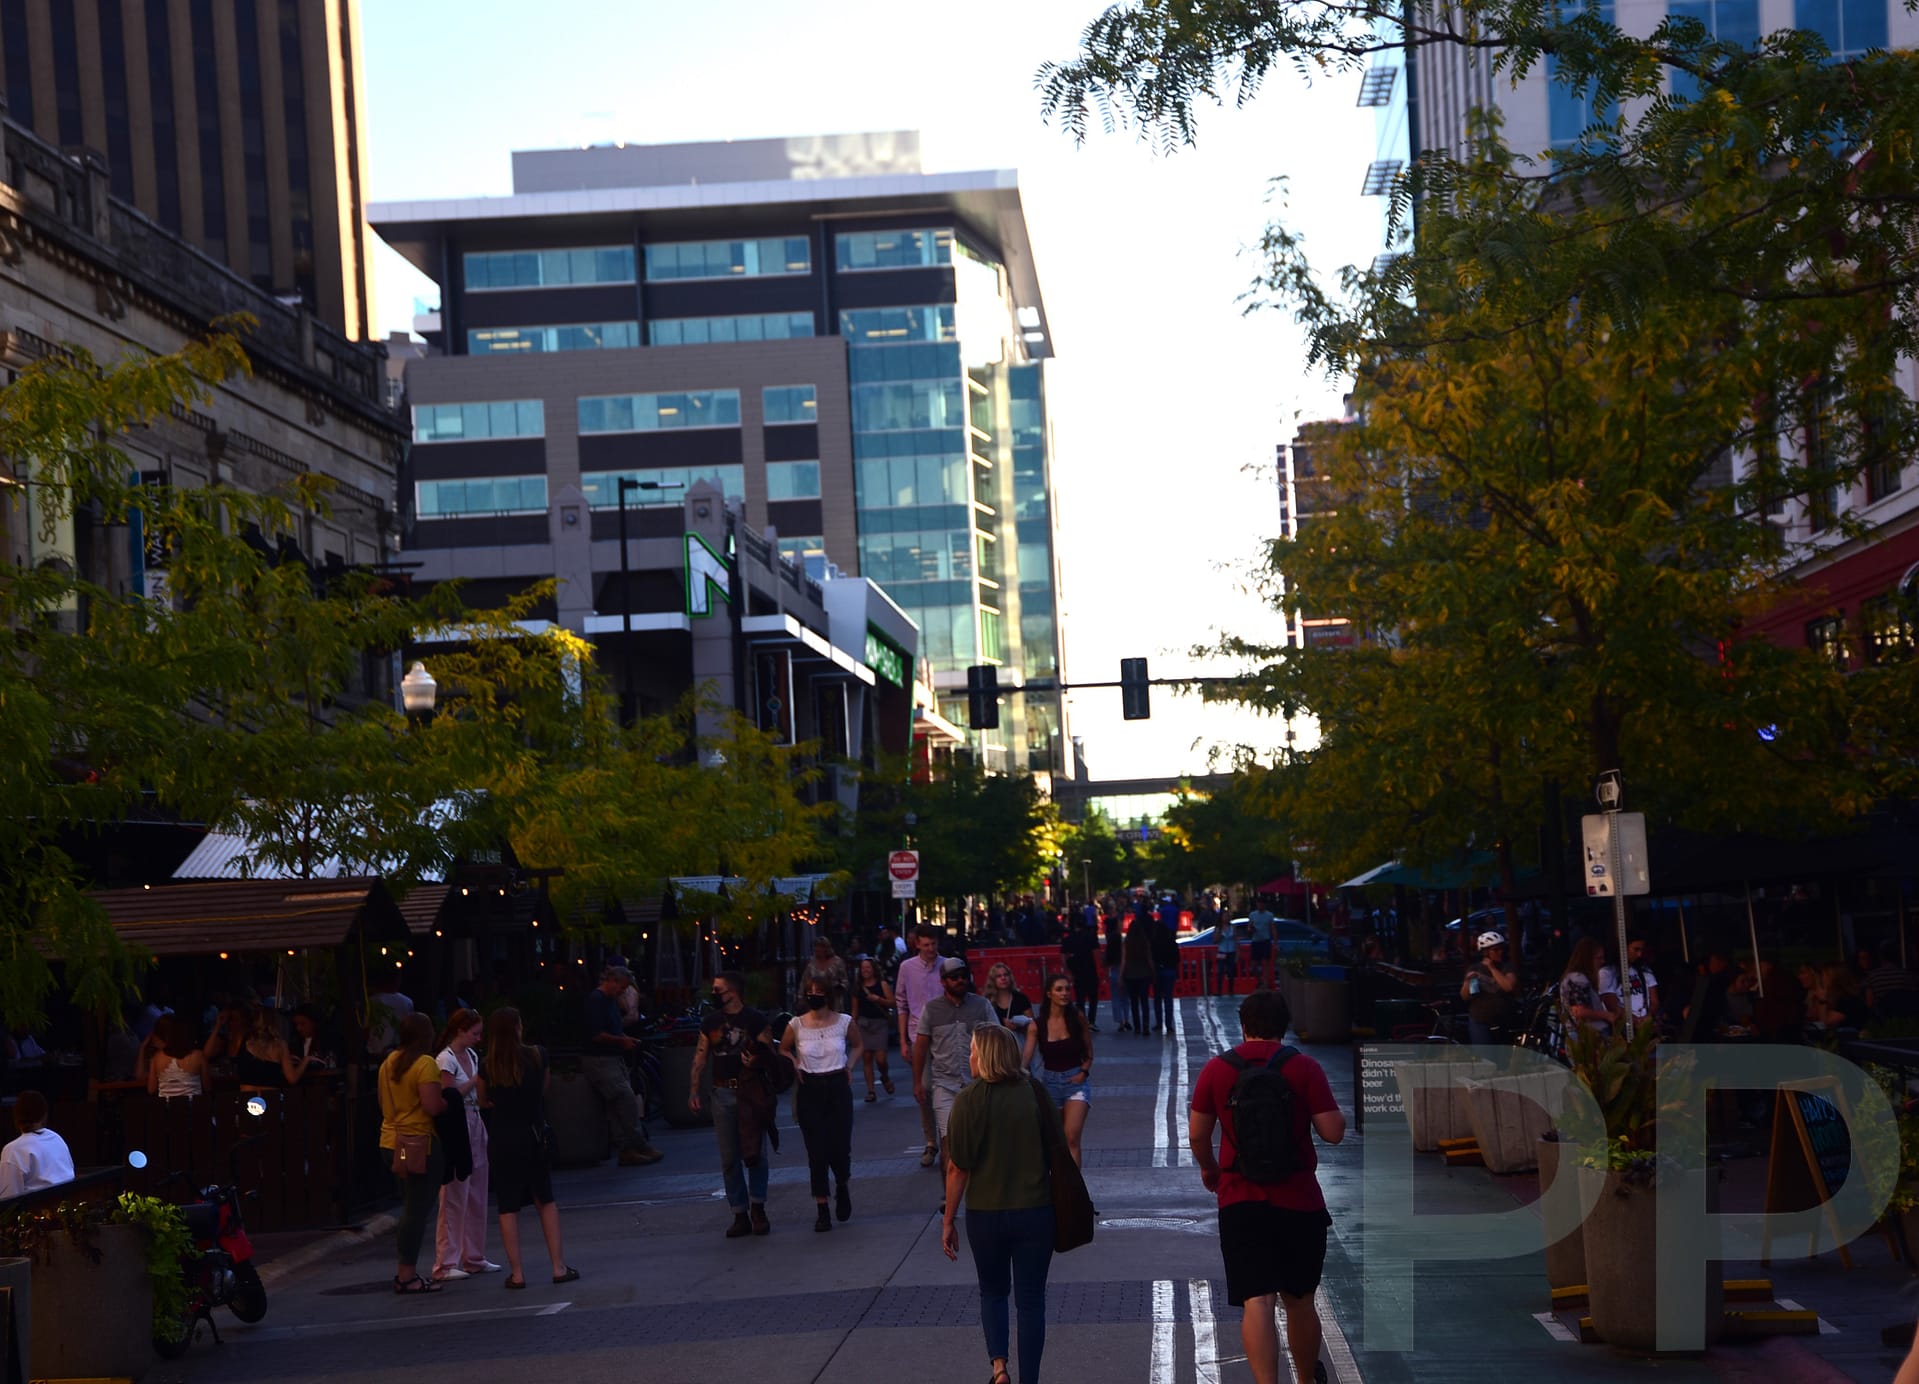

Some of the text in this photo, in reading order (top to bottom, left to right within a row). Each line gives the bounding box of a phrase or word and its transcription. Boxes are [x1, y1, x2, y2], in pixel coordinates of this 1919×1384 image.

[1362, 1069, 1388, 1078] didn't
[1362, 1080, 1383, 1088] beer
[1363, 1093, 1393, 1103] How'd
[1363, 1104, 1388, 1113] work
